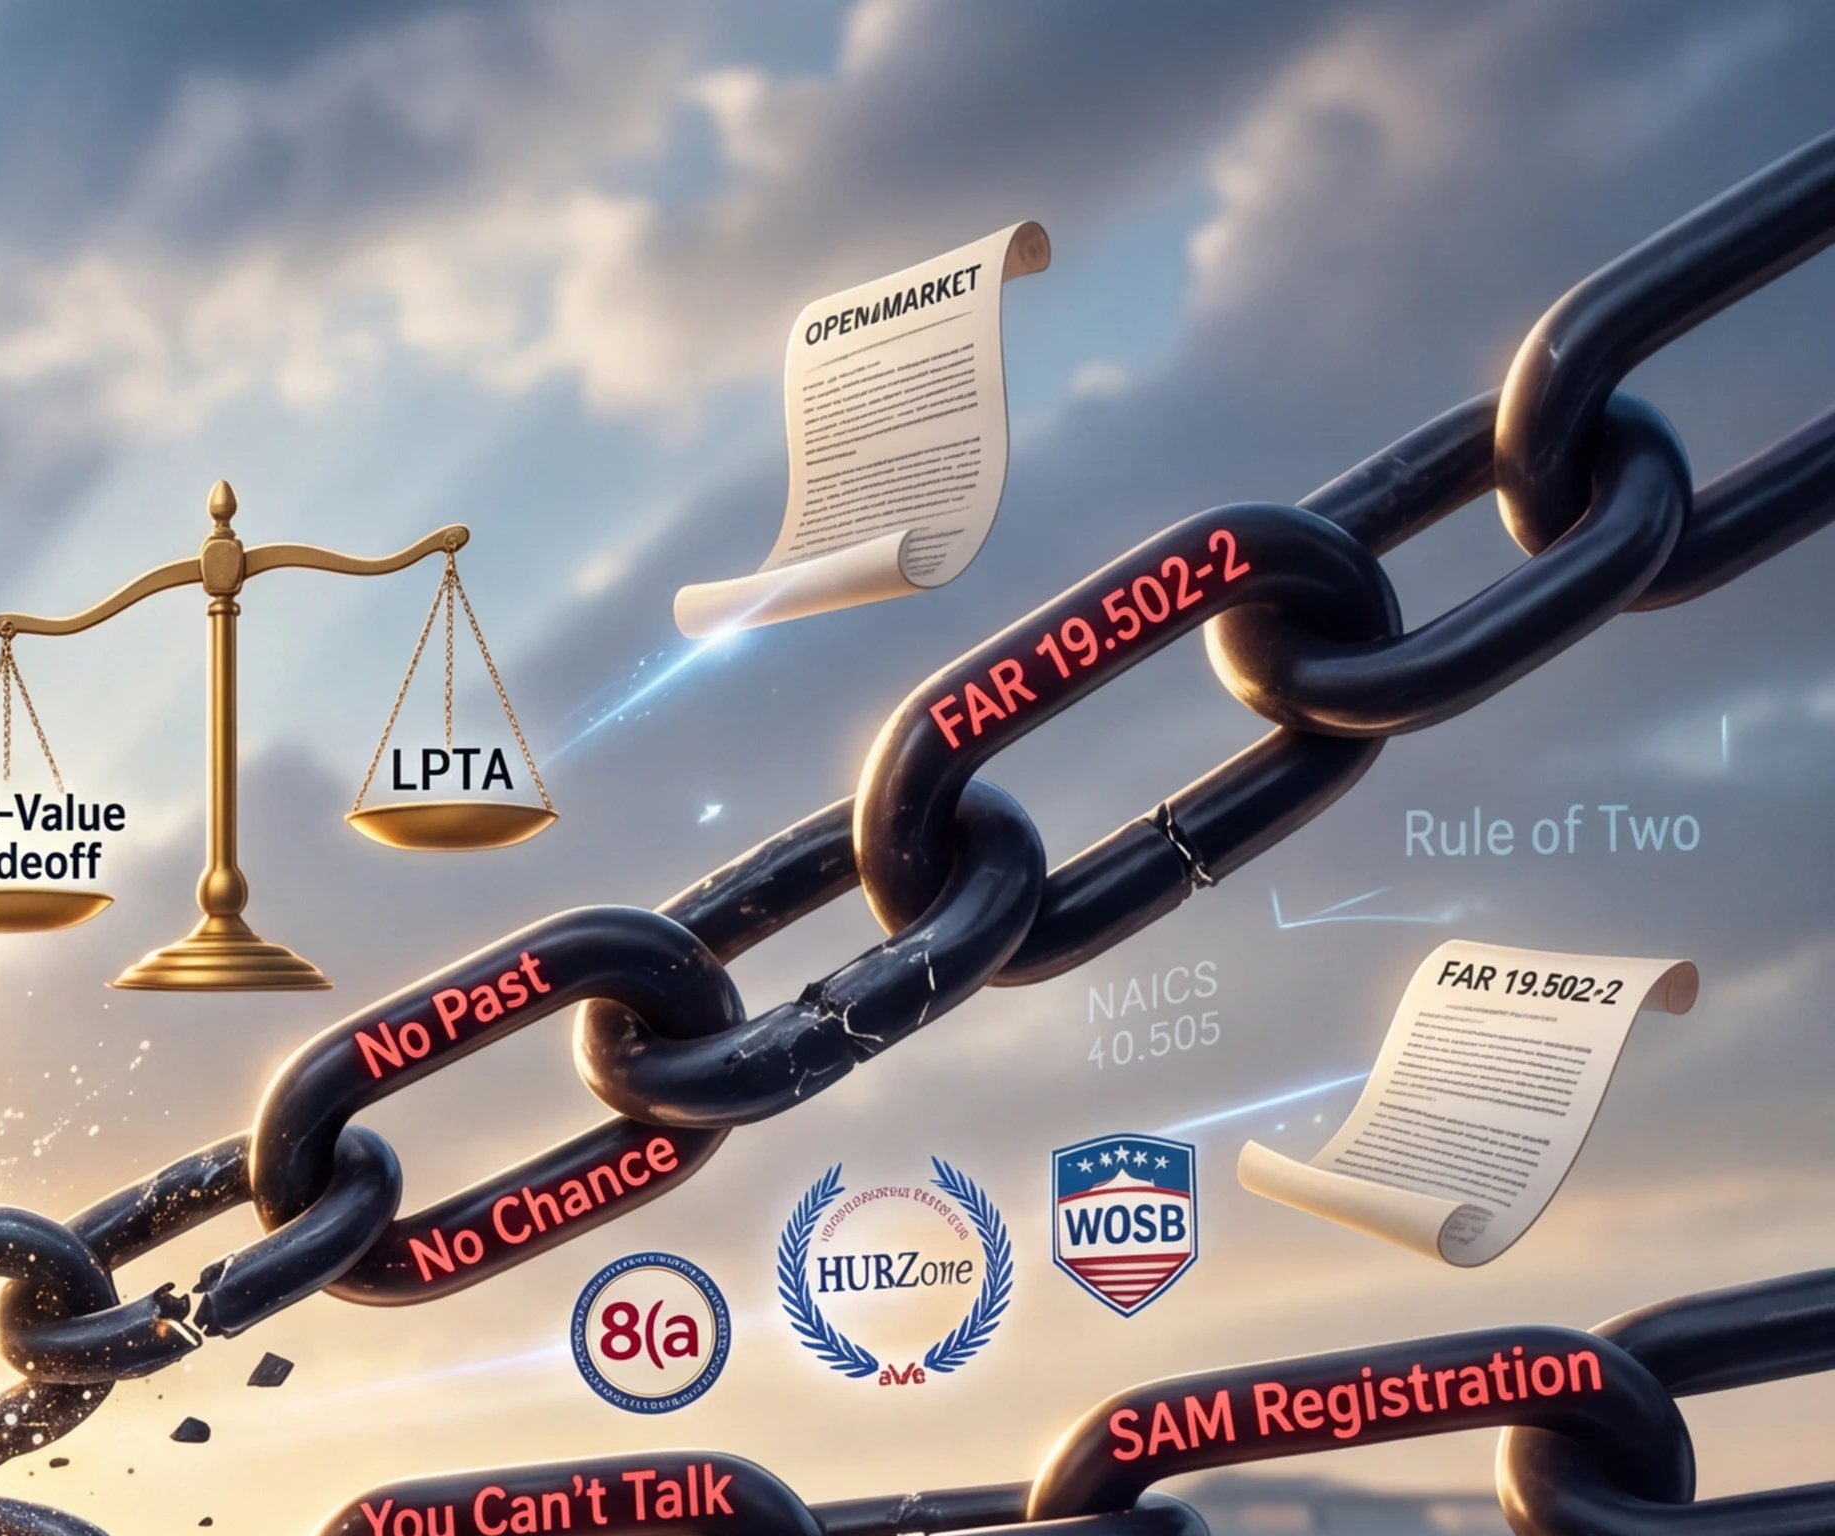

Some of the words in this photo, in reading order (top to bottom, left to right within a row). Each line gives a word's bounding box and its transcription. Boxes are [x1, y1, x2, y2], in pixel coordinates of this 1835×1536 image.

[930, 659, 1036, 748] FAR
[1036, 530, 1249, 678] 19.502-2
[391, 747, 514, 791] LPTA
[1405, 808, 1515, 857] Rule
[1532, 805, 1583, 854] of
[1599, 804, 1701, 852] Two
[1089, 960, 1218, 1024] NAICS
[1436, 960, 1497, 991] FAR
[355, 1022, 430, 1078] No
[433, 952, 550, 1039] Past
[1087, 1010, 1221, 1070] 40.505
[409, 1229, 483, 1281] No
[493, 1138, 677, 1243] Chance
[1063, 1203, 1187, 1247] WOSB
[600, 1299, 699, 1370] 8(a
[1110, 1390, 1235, 1460] SAM
[1253, 1346, 1601, 1438] Registration
[622, 1464, 733, 1520] Talk
